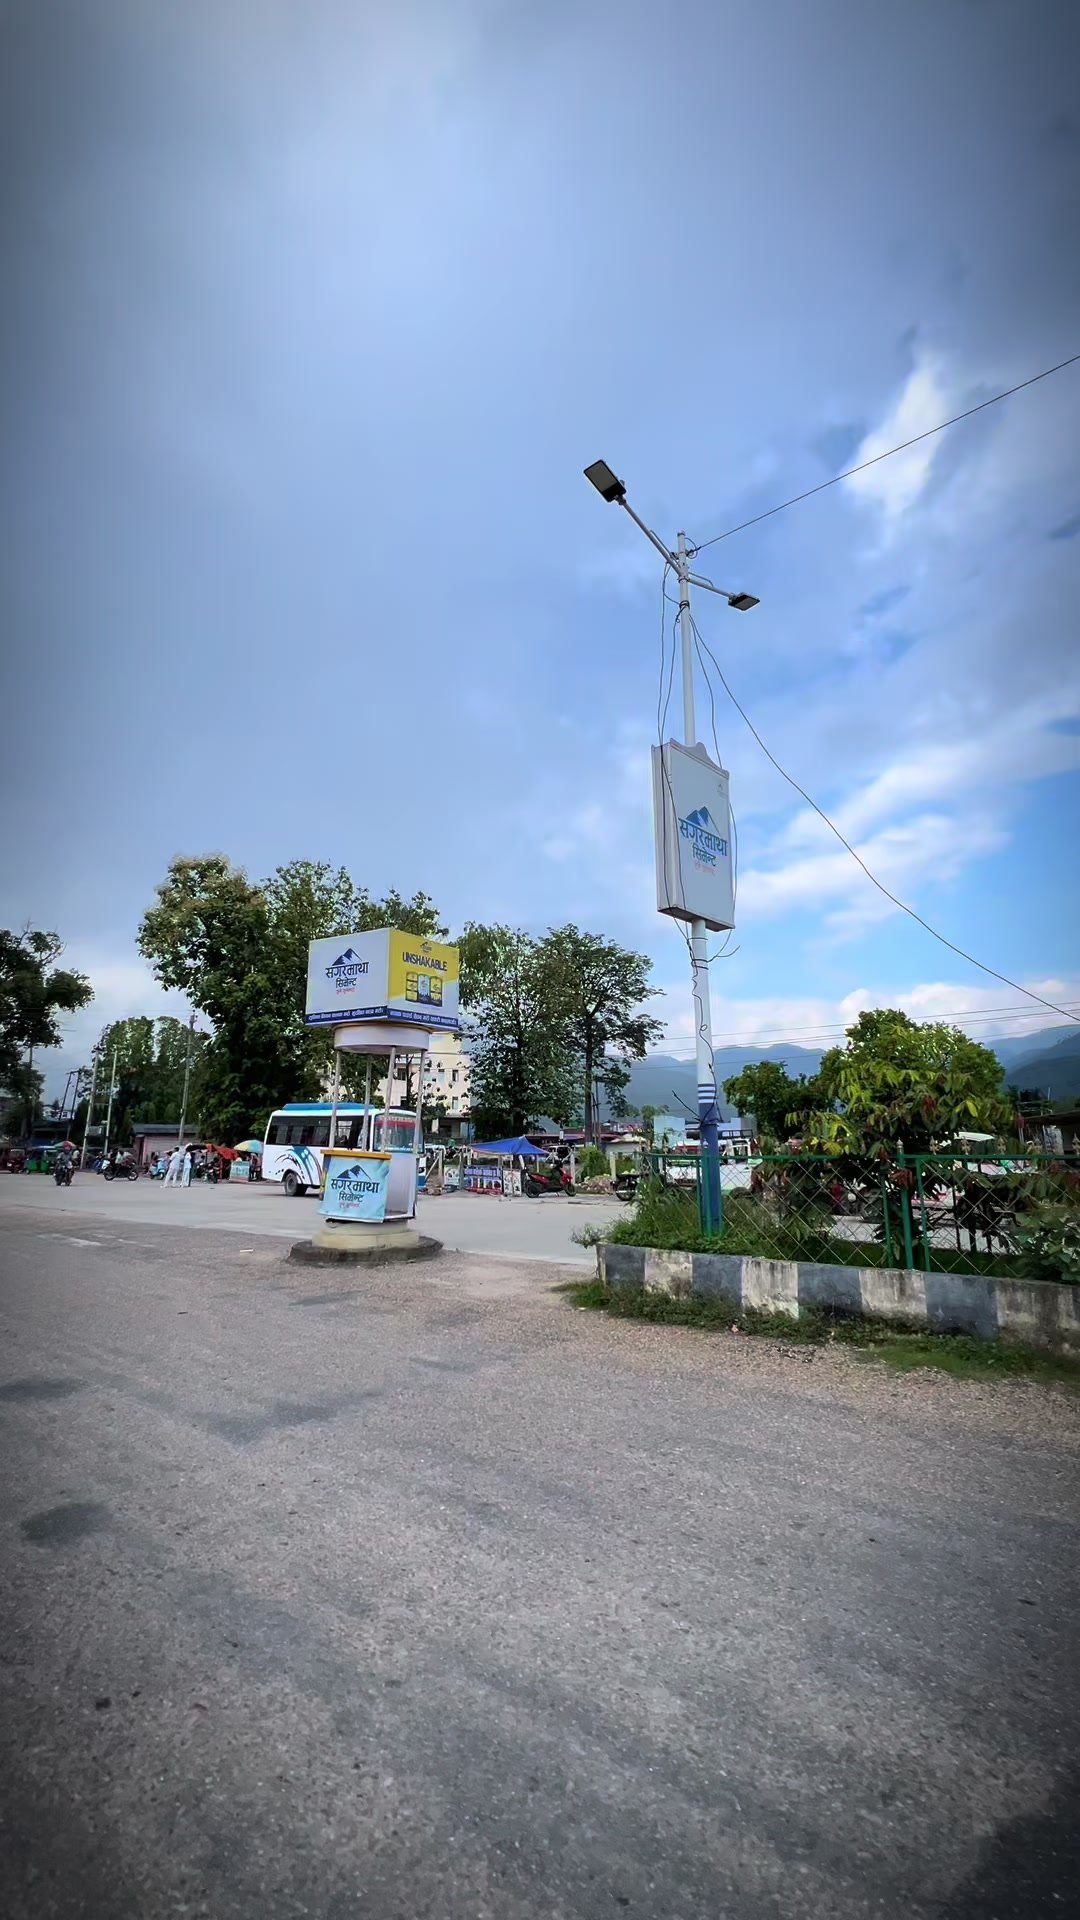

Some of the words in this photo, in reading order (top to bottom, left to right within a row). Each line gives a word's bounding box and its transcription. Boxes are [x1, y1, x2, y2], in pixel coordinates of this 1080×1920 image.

[678, 817, 728, 857] सगरमाथा
[325, 961, 370, 979] सगरमाथा
[402, 951, 448, 972] UNSHAKABLE
[330, 1178, 381, 1194] सगरमाथा
